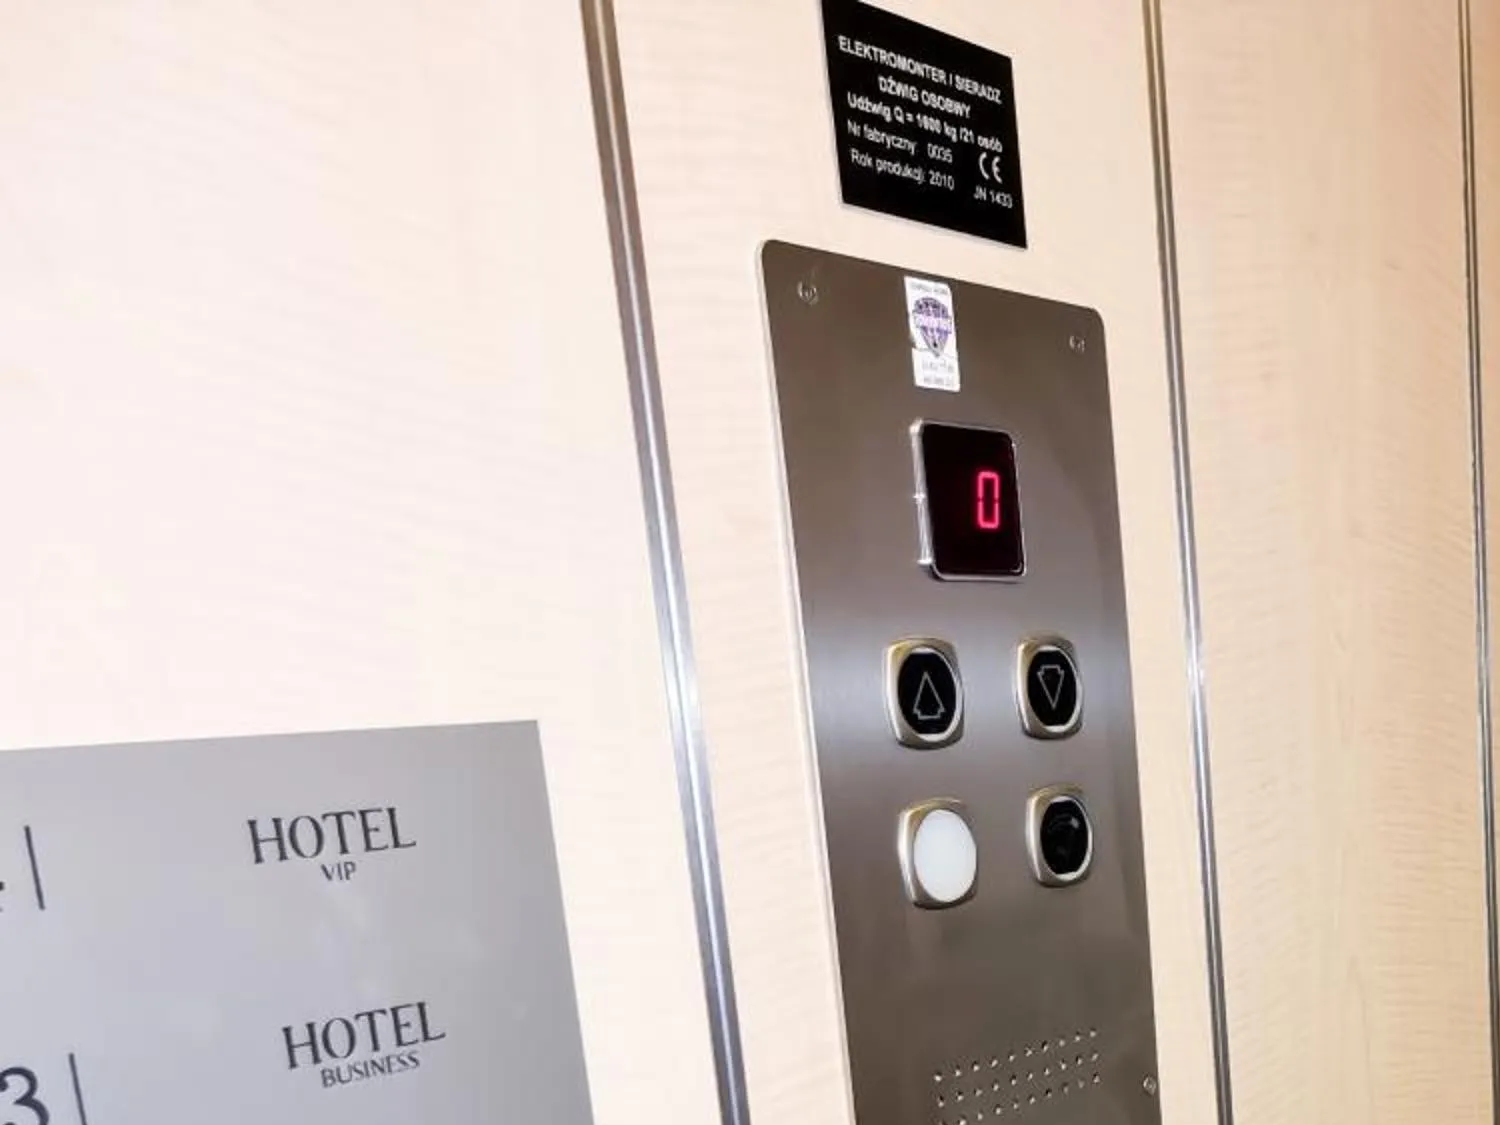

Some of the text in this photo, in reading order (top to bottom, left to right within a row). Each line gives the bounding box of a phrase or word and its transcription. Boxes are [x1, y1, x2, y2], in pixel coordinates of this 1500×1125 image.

[838, 35, 947, 85] ELEKTROMONTER
[954, 74, 1003, 104] SIERADZ
[847, 119, 861, 136] Nr
[893, 105, 905, 124] Q
[906, 112, 914, 122] =
[943, 121, 957, 142] kg
[850, 147, 874, 168] Rok
[928, 169, 955, 191] 2010
[977, 470, 1000, 529] 0
[246, 806, 417, 864] HOTEL
[320, 861, 358, 882] VIP
[282, 1001, 446, 1070] HOTEL
[320, 1051, 420, 1089] BUSINESS
